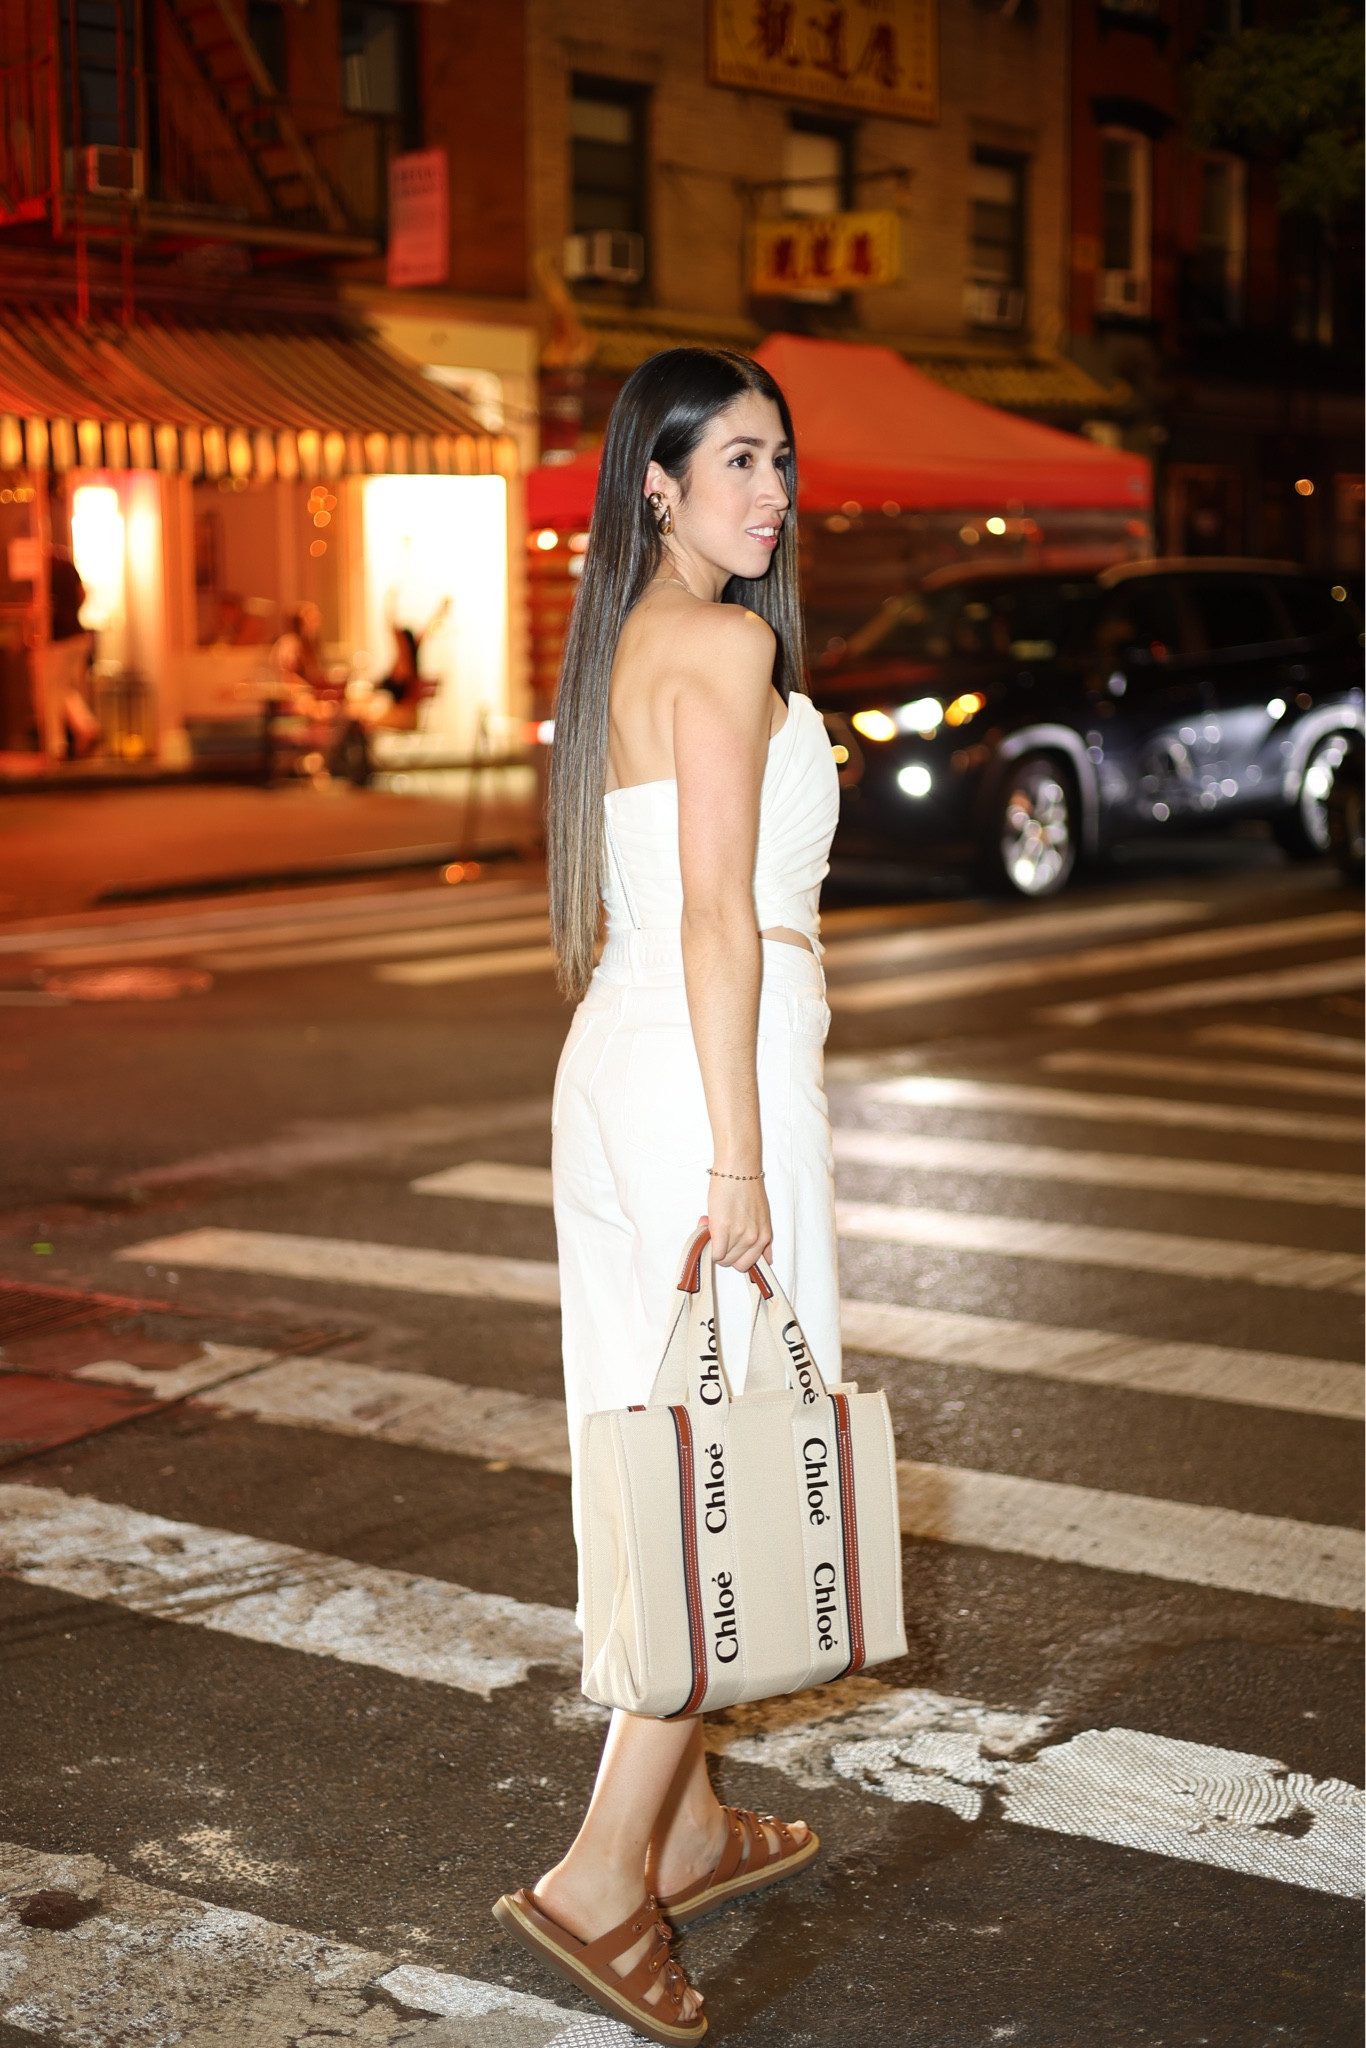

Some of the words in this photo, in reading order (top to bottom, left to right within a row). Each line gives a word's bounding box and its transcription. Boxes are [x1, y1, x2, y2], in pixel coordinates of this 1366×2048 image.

[781, 1319, 819, 1405] Chloé
[704, 1442, 727, 1534] Chloé
[802, 1437, 831, 1526] Chloé
[711, 1571, 739, 1664] Chloé
[813, 1562, 839, 1651] Chloé
